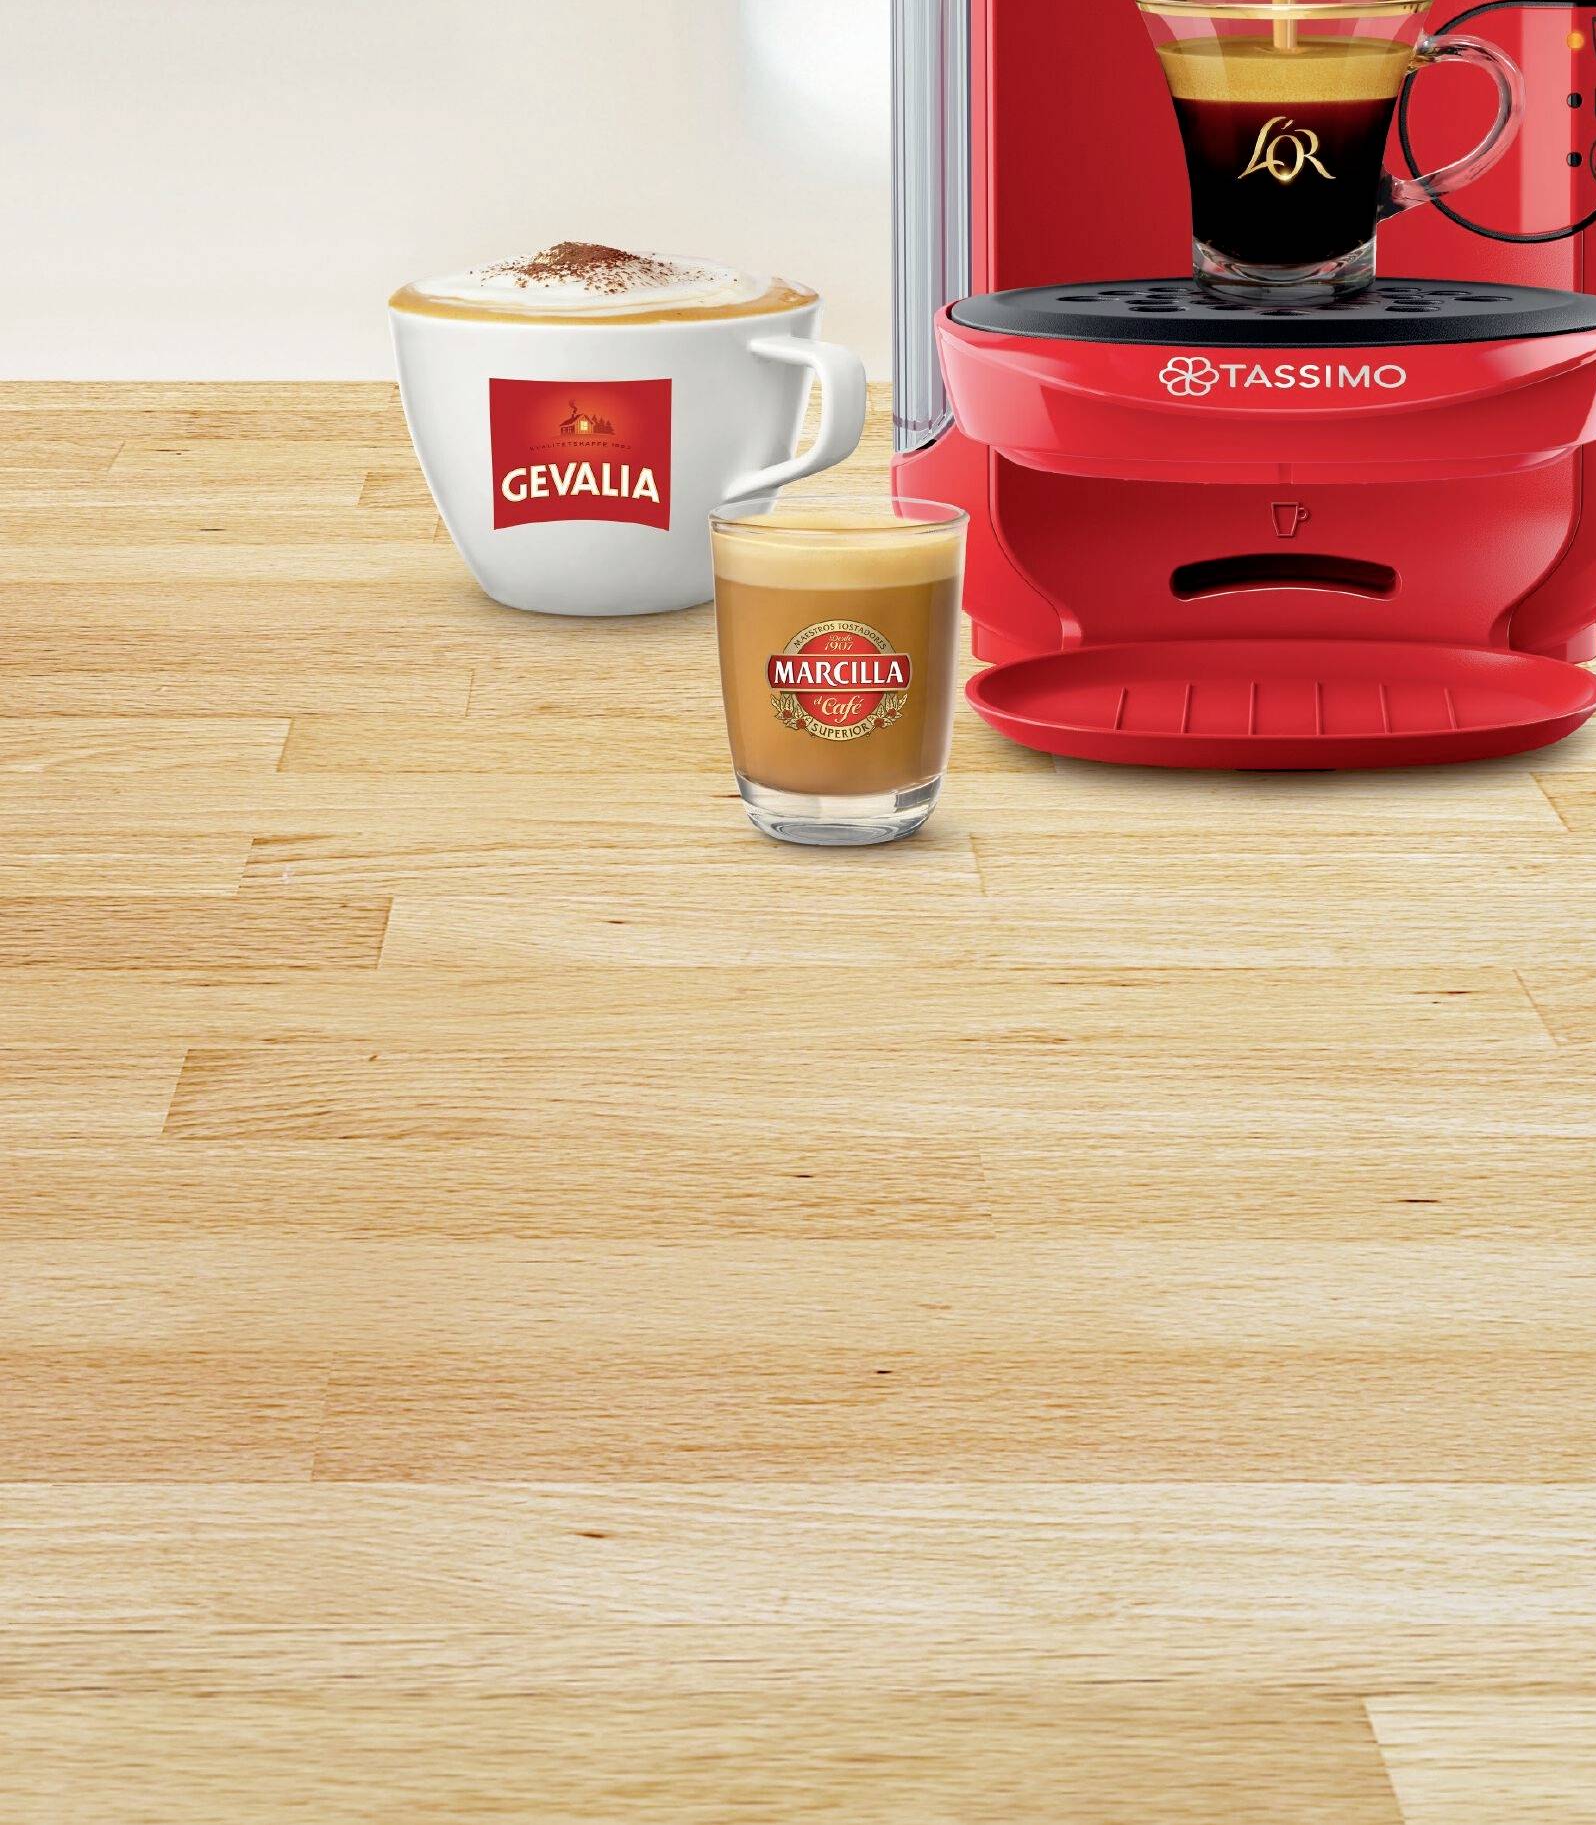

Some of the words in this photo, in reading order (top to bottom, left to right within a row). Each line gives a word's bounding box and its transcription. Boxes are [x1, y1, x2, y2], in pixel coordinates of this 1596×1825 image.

[1219, 364, 1407, 388] TASSIMO
[501, 461, 660, 503] GEVALIA
[793, 623, 835, 648] MAESTROS
[837, 622, 887, 650] TOSTADORES
[774, 661, 904, 687] MARCILLA
[821, 695, 864, 723] Café
[811, 722, 870, 738] SUPERIOR
